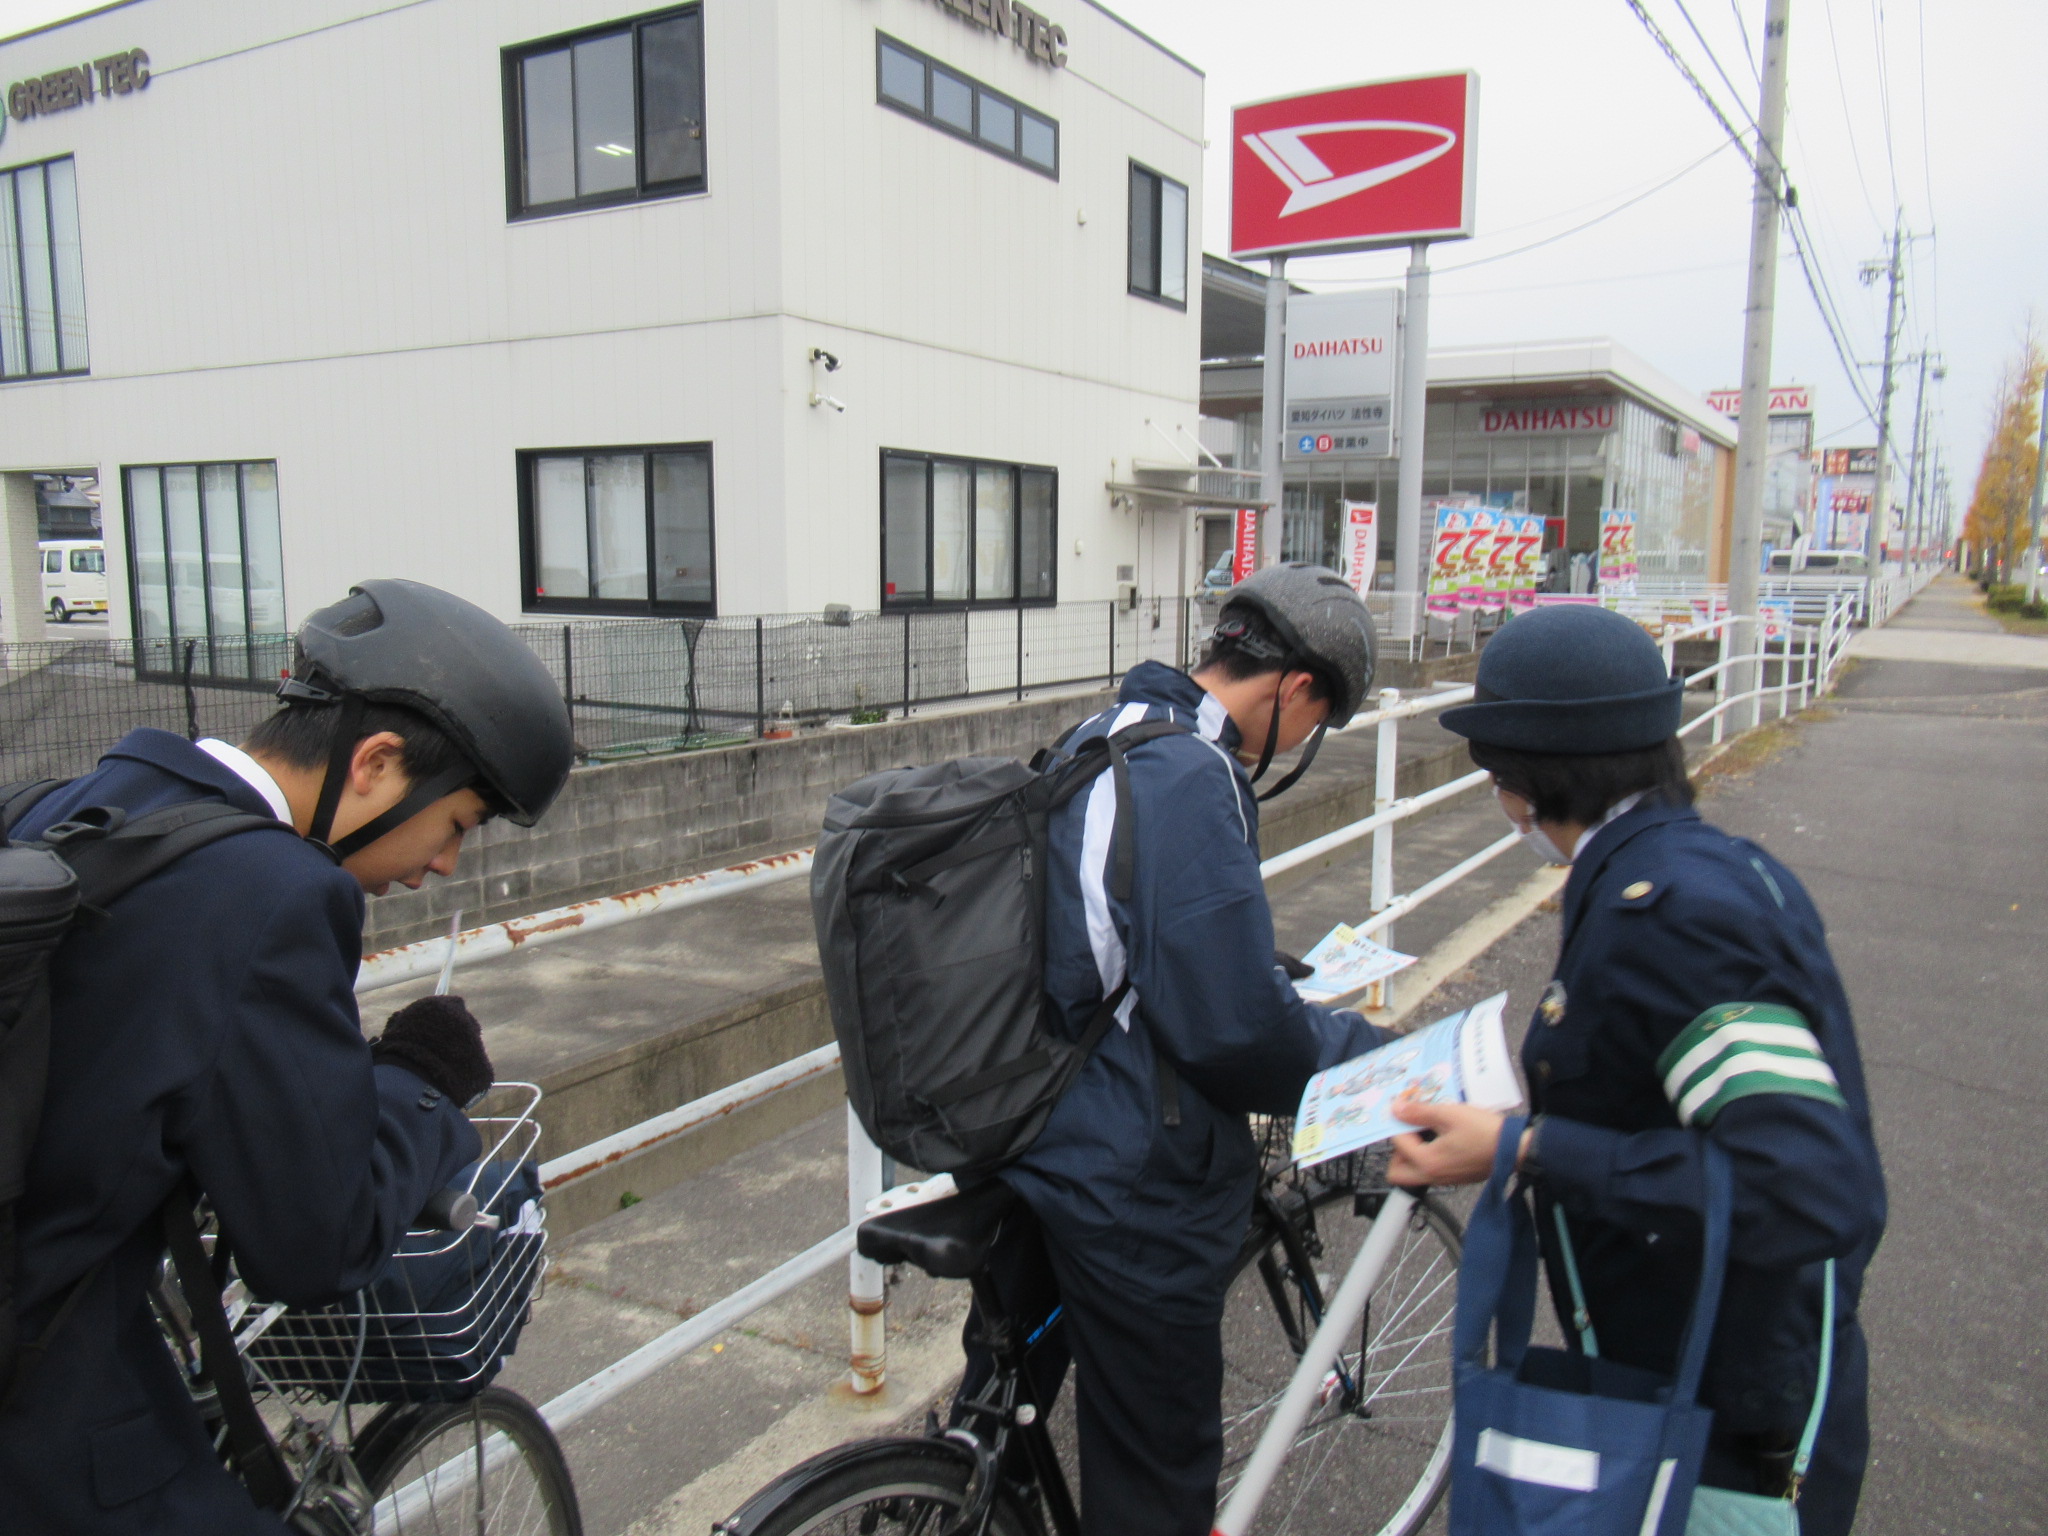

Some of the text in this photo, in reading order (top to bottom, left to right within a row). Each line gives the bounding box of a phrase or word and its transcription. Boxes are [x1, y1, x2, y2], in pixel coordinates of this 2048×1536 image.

[1012, 0, 1068, 67] TEC
[8, 47, 150, 121] GREEN TEC
[1294, 338, 1383, 359] DAIHATSU
[1484, 405, 1614, 432] DAIHATSU
[1706, 394, 1808, 412] NIAN
[1241, 509, 1257, 578] DAIHATS
[1436, 532, 1467, 566] 7
[1463, 529, 1492, 561] 7
[1488, 536, 1516, 567] 7
[1514, 536, 1540, 565] 7
[1349, 529, 1367, 595] DAIHATS
